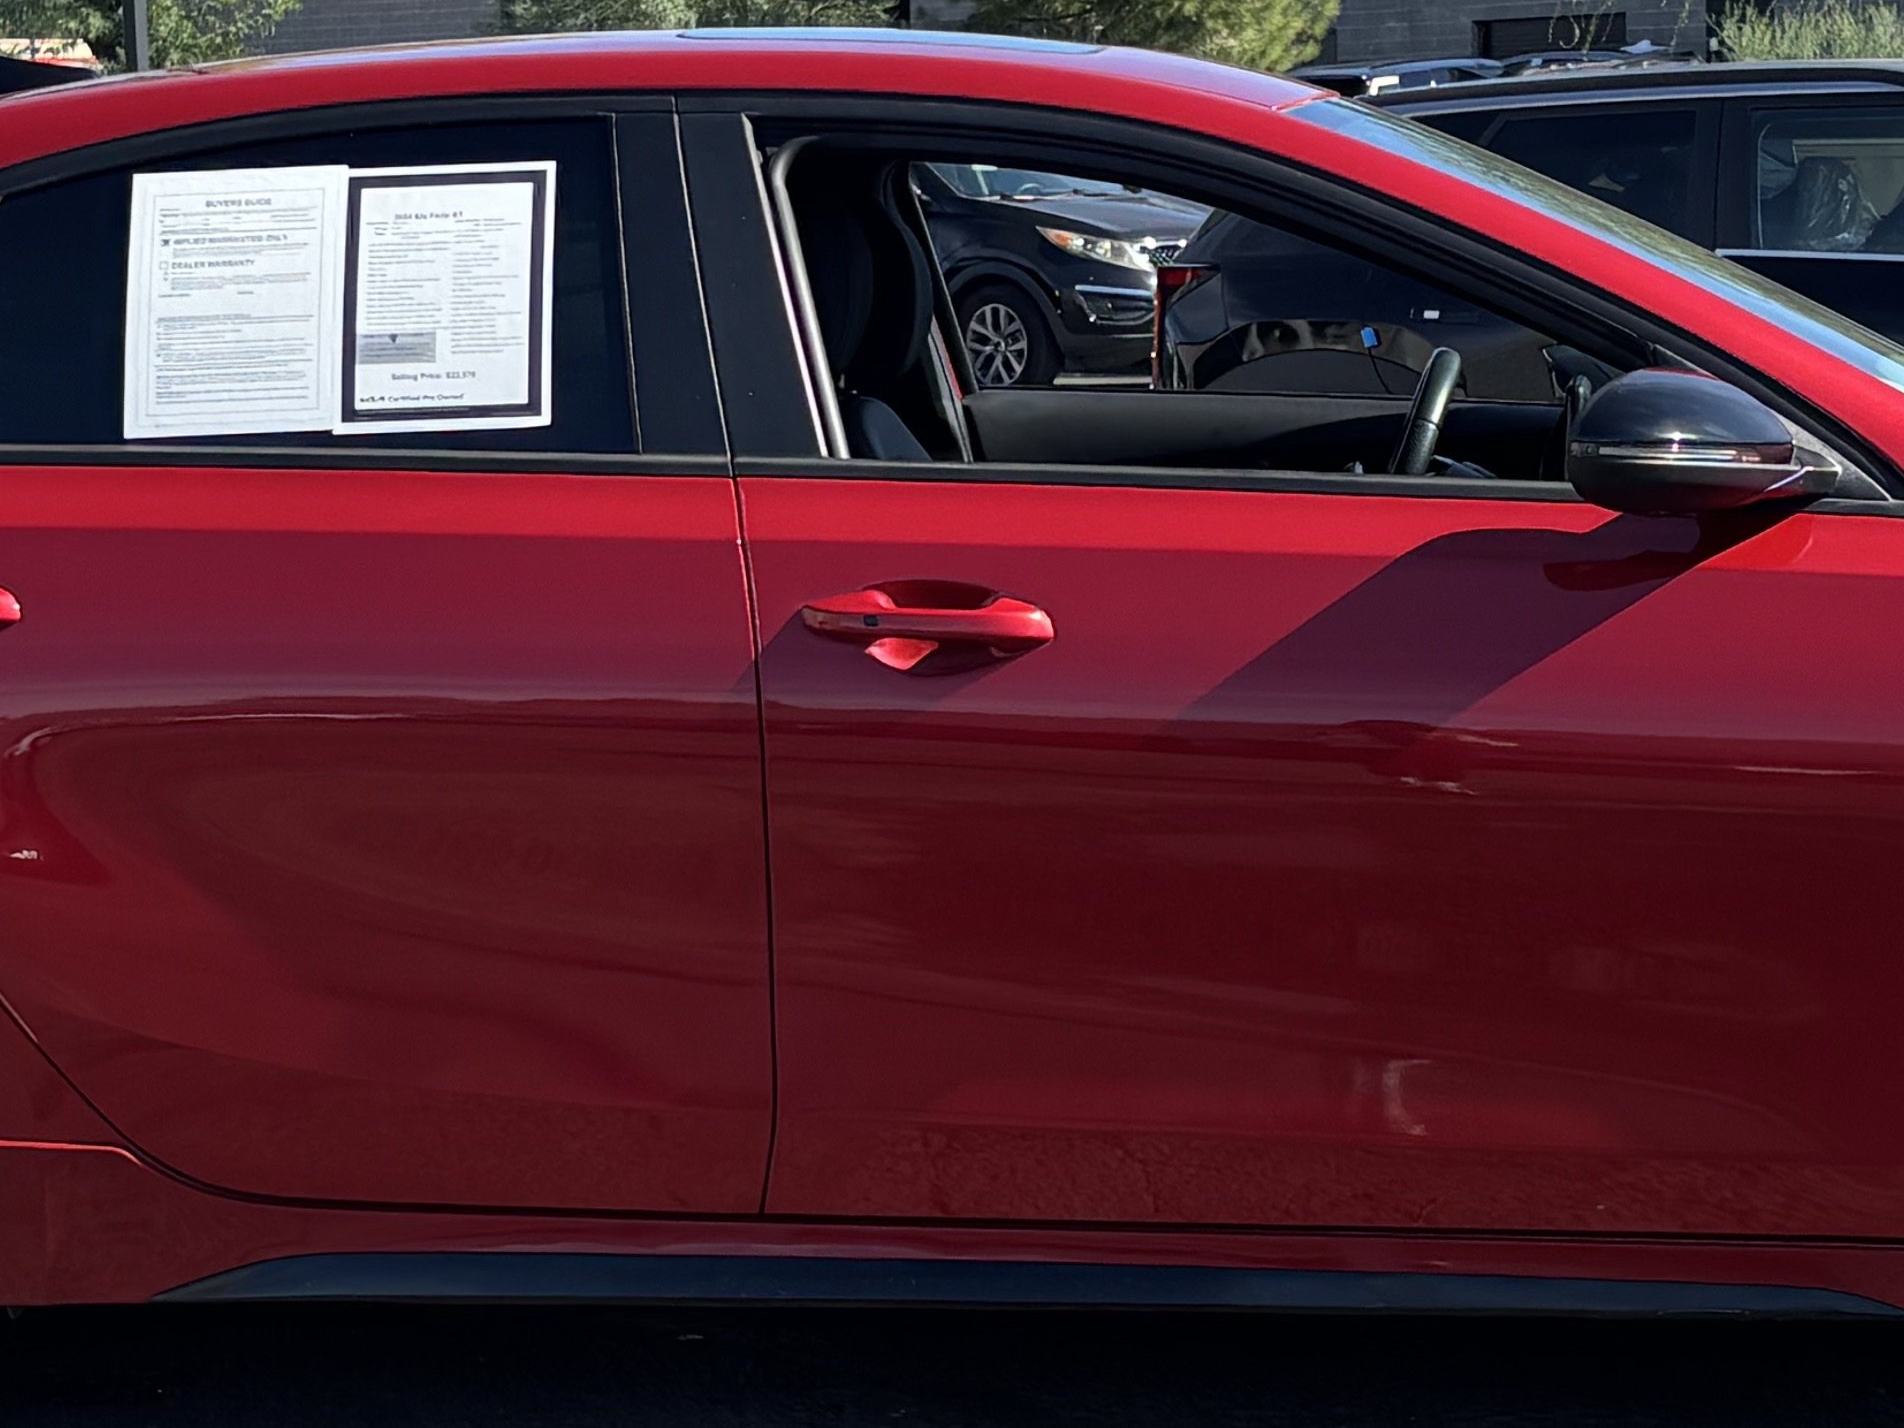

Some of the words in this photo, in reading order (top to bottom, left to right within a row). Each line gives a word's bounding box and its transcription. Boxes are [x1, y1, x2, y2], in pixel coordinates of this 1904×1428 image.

[205, 199, 242, 208] BUYERS
[244, 198, 272, 207] GUIDE
[171, 261, 205, 270] DEALER
[208, 259, 256, 269] WARRANTY
[391, 373, 418, 382] Selling
